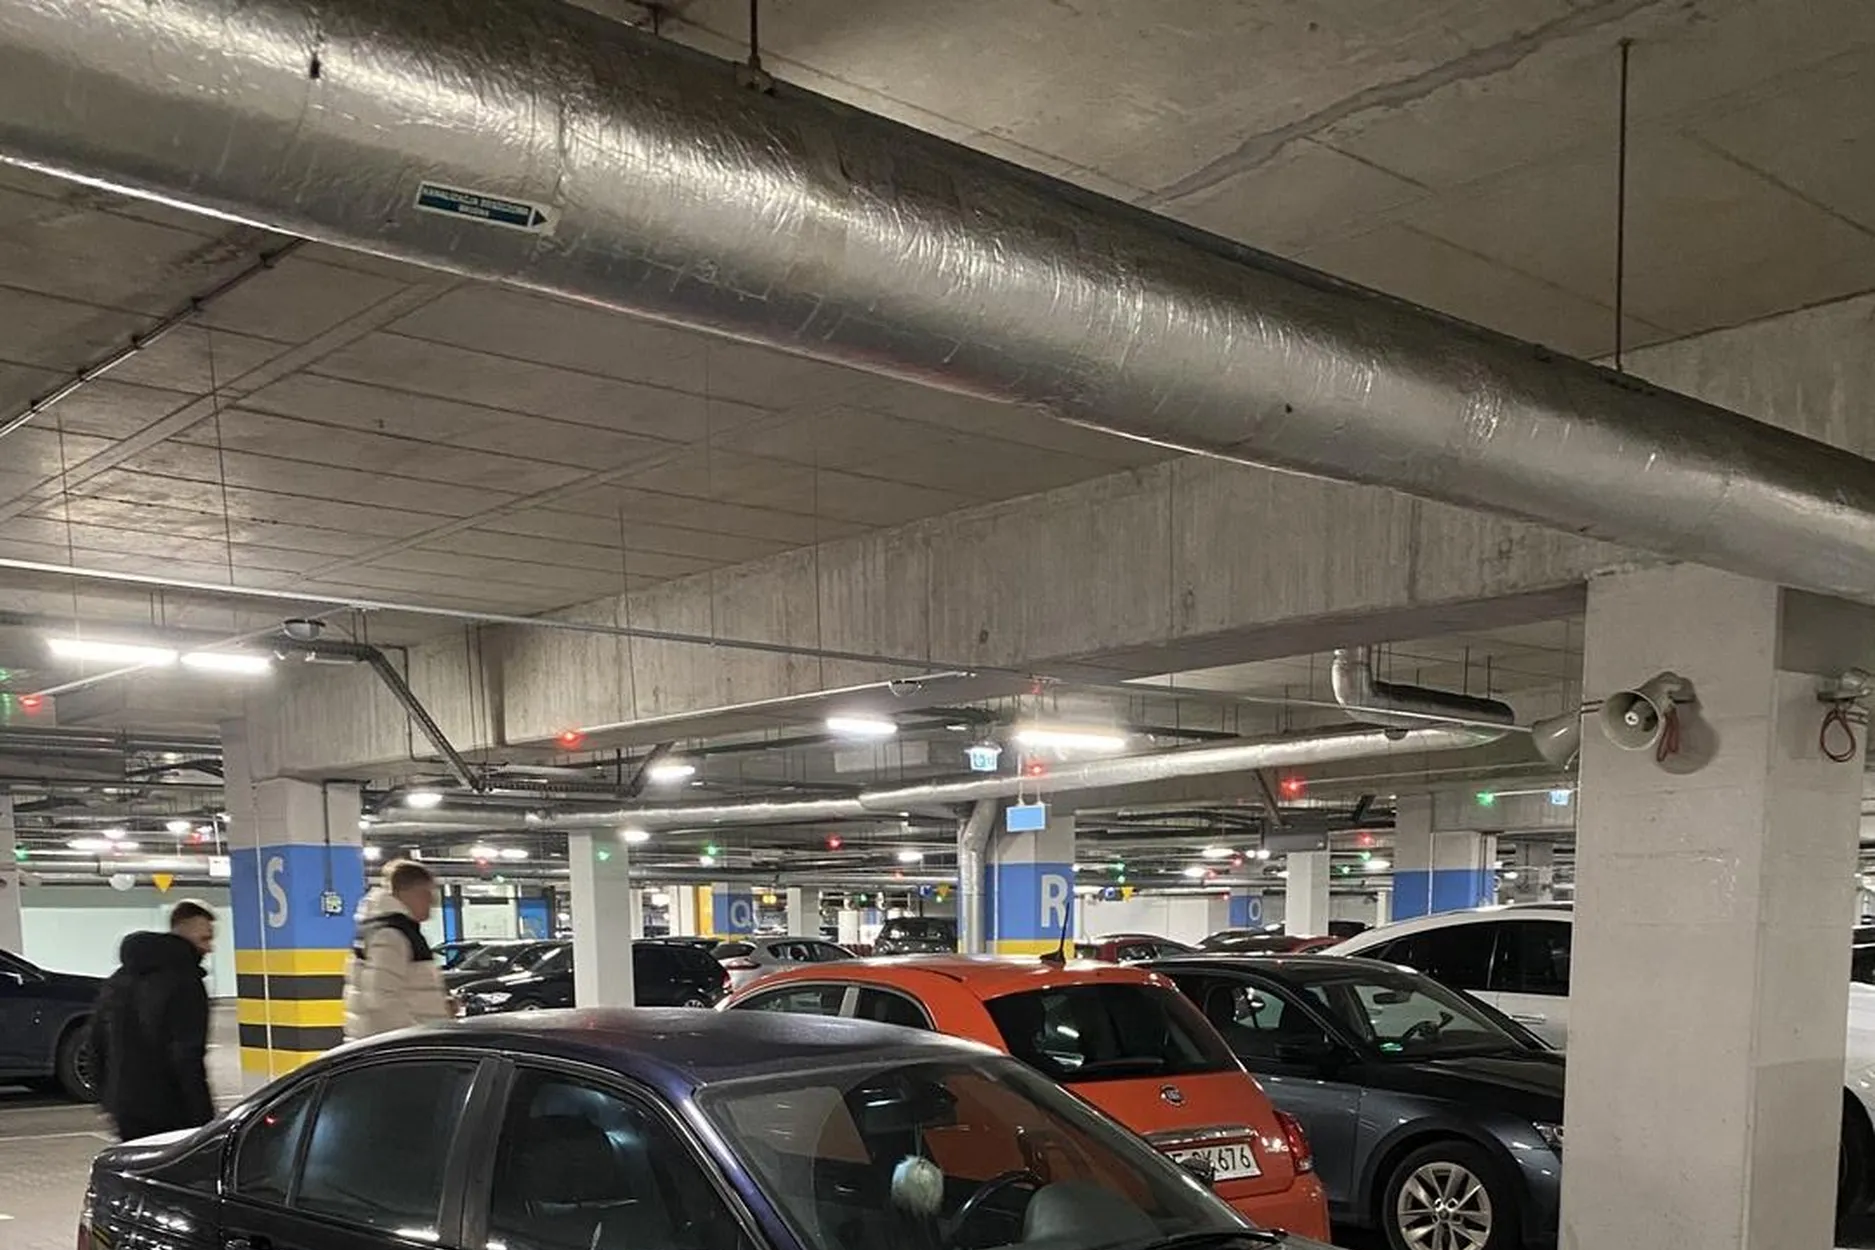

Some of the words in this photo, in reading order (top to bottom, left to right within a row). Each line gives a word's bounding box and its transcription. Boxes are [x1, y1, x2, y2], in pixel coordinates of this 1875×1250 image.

[265, 856, 288, 928] S
[731, 900, 752, 928] Q
[1041, 874, 1070, 928] R
